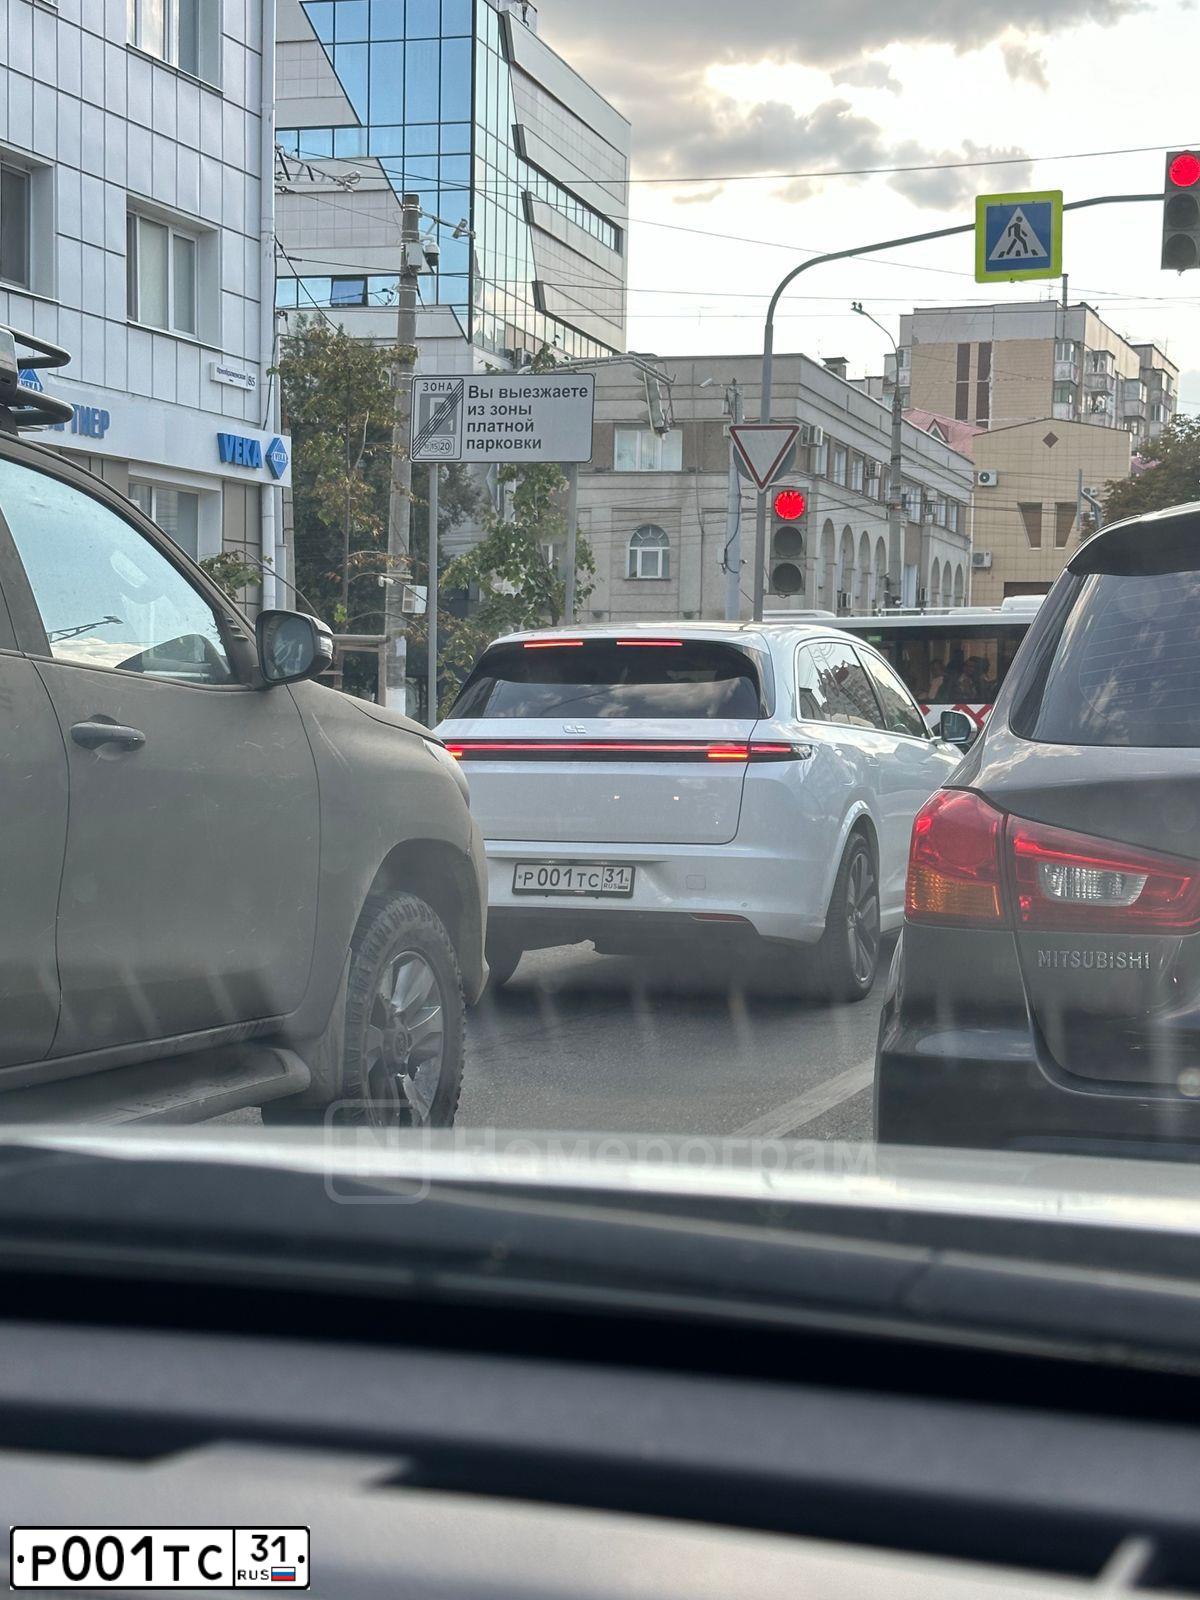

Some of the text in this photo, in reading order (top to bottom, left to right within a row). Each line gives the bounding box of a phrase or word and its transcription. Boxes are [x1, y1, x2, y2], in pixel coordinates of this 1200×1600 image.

[422, 382, 453, 392] ЗОНА
[468, 385, 588, 399] Вы выезжаете
[467, 404, 532, 416] из зоны
[447, 419, 454, 432] 1
[467, 418, 534, 433] платной
[217, 433, 264, 469] VEKA
[440, 442, 451, 451] 20
[466, 438, 542, 453] парковки
[604, 869, 626, 883] 31
